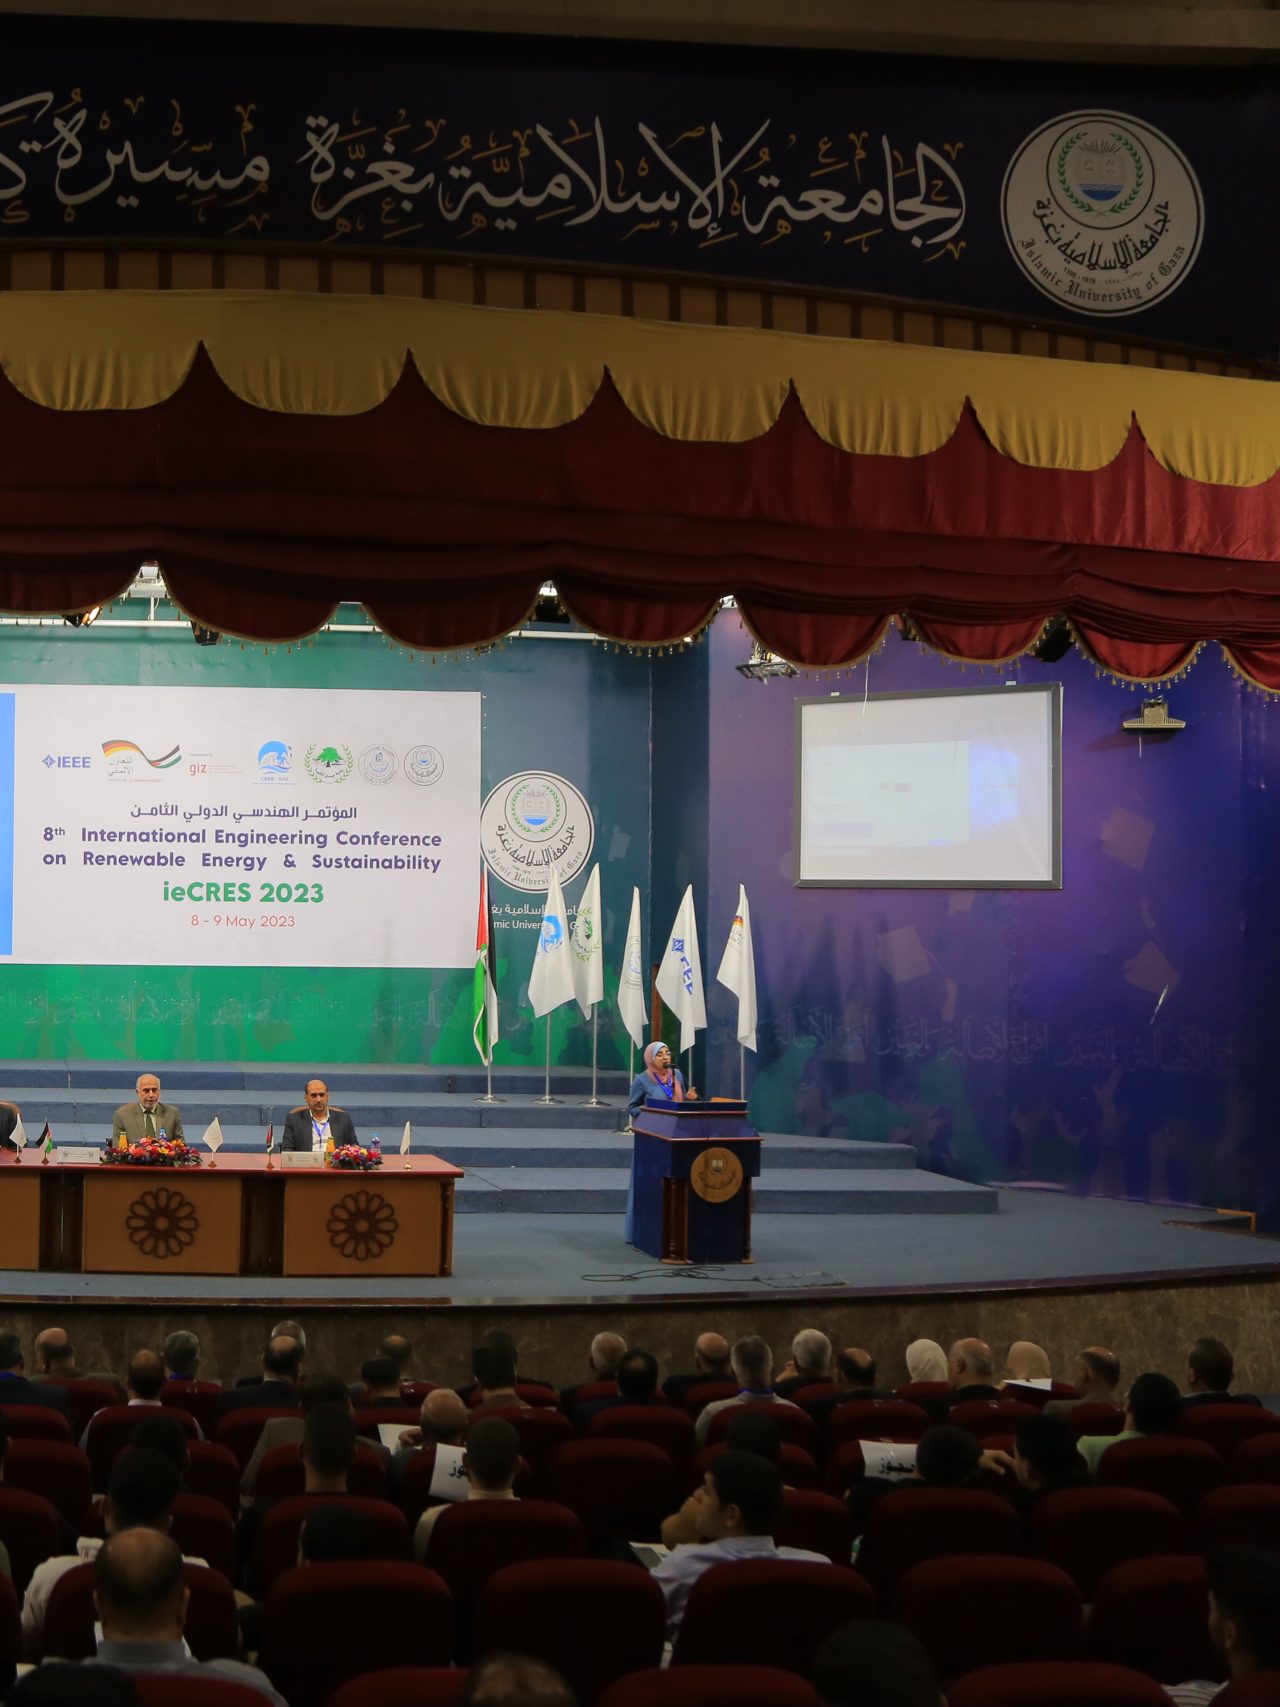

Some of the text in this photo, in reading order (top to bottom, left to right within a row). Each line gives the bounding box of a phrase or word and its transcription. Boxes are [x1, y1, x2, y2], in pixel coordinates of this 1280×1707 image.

[1017, 238, 1062, 287] Islamic
[1064, 279, 1143, 303] University
[57, 756, 91, 768] IEEE
[189, 763, 207, 776] giz
[130, 802, 358, 824] المؤتمر الهندسي الدولي الثامن
[43, 826, 442, 849] 8th International Engineering Conference
[42, 851, 442, 874] on Renewable Energy & Sustainability
[511, 871, 549, 885] Universi
[163, 880, 325, 903] ieCRES 2023
[191, 914, 199, 926] 8
[213, 915, 222, 927] 9
[226, 915, 256, 929] May
[260, 915, 296, 927] 2023
